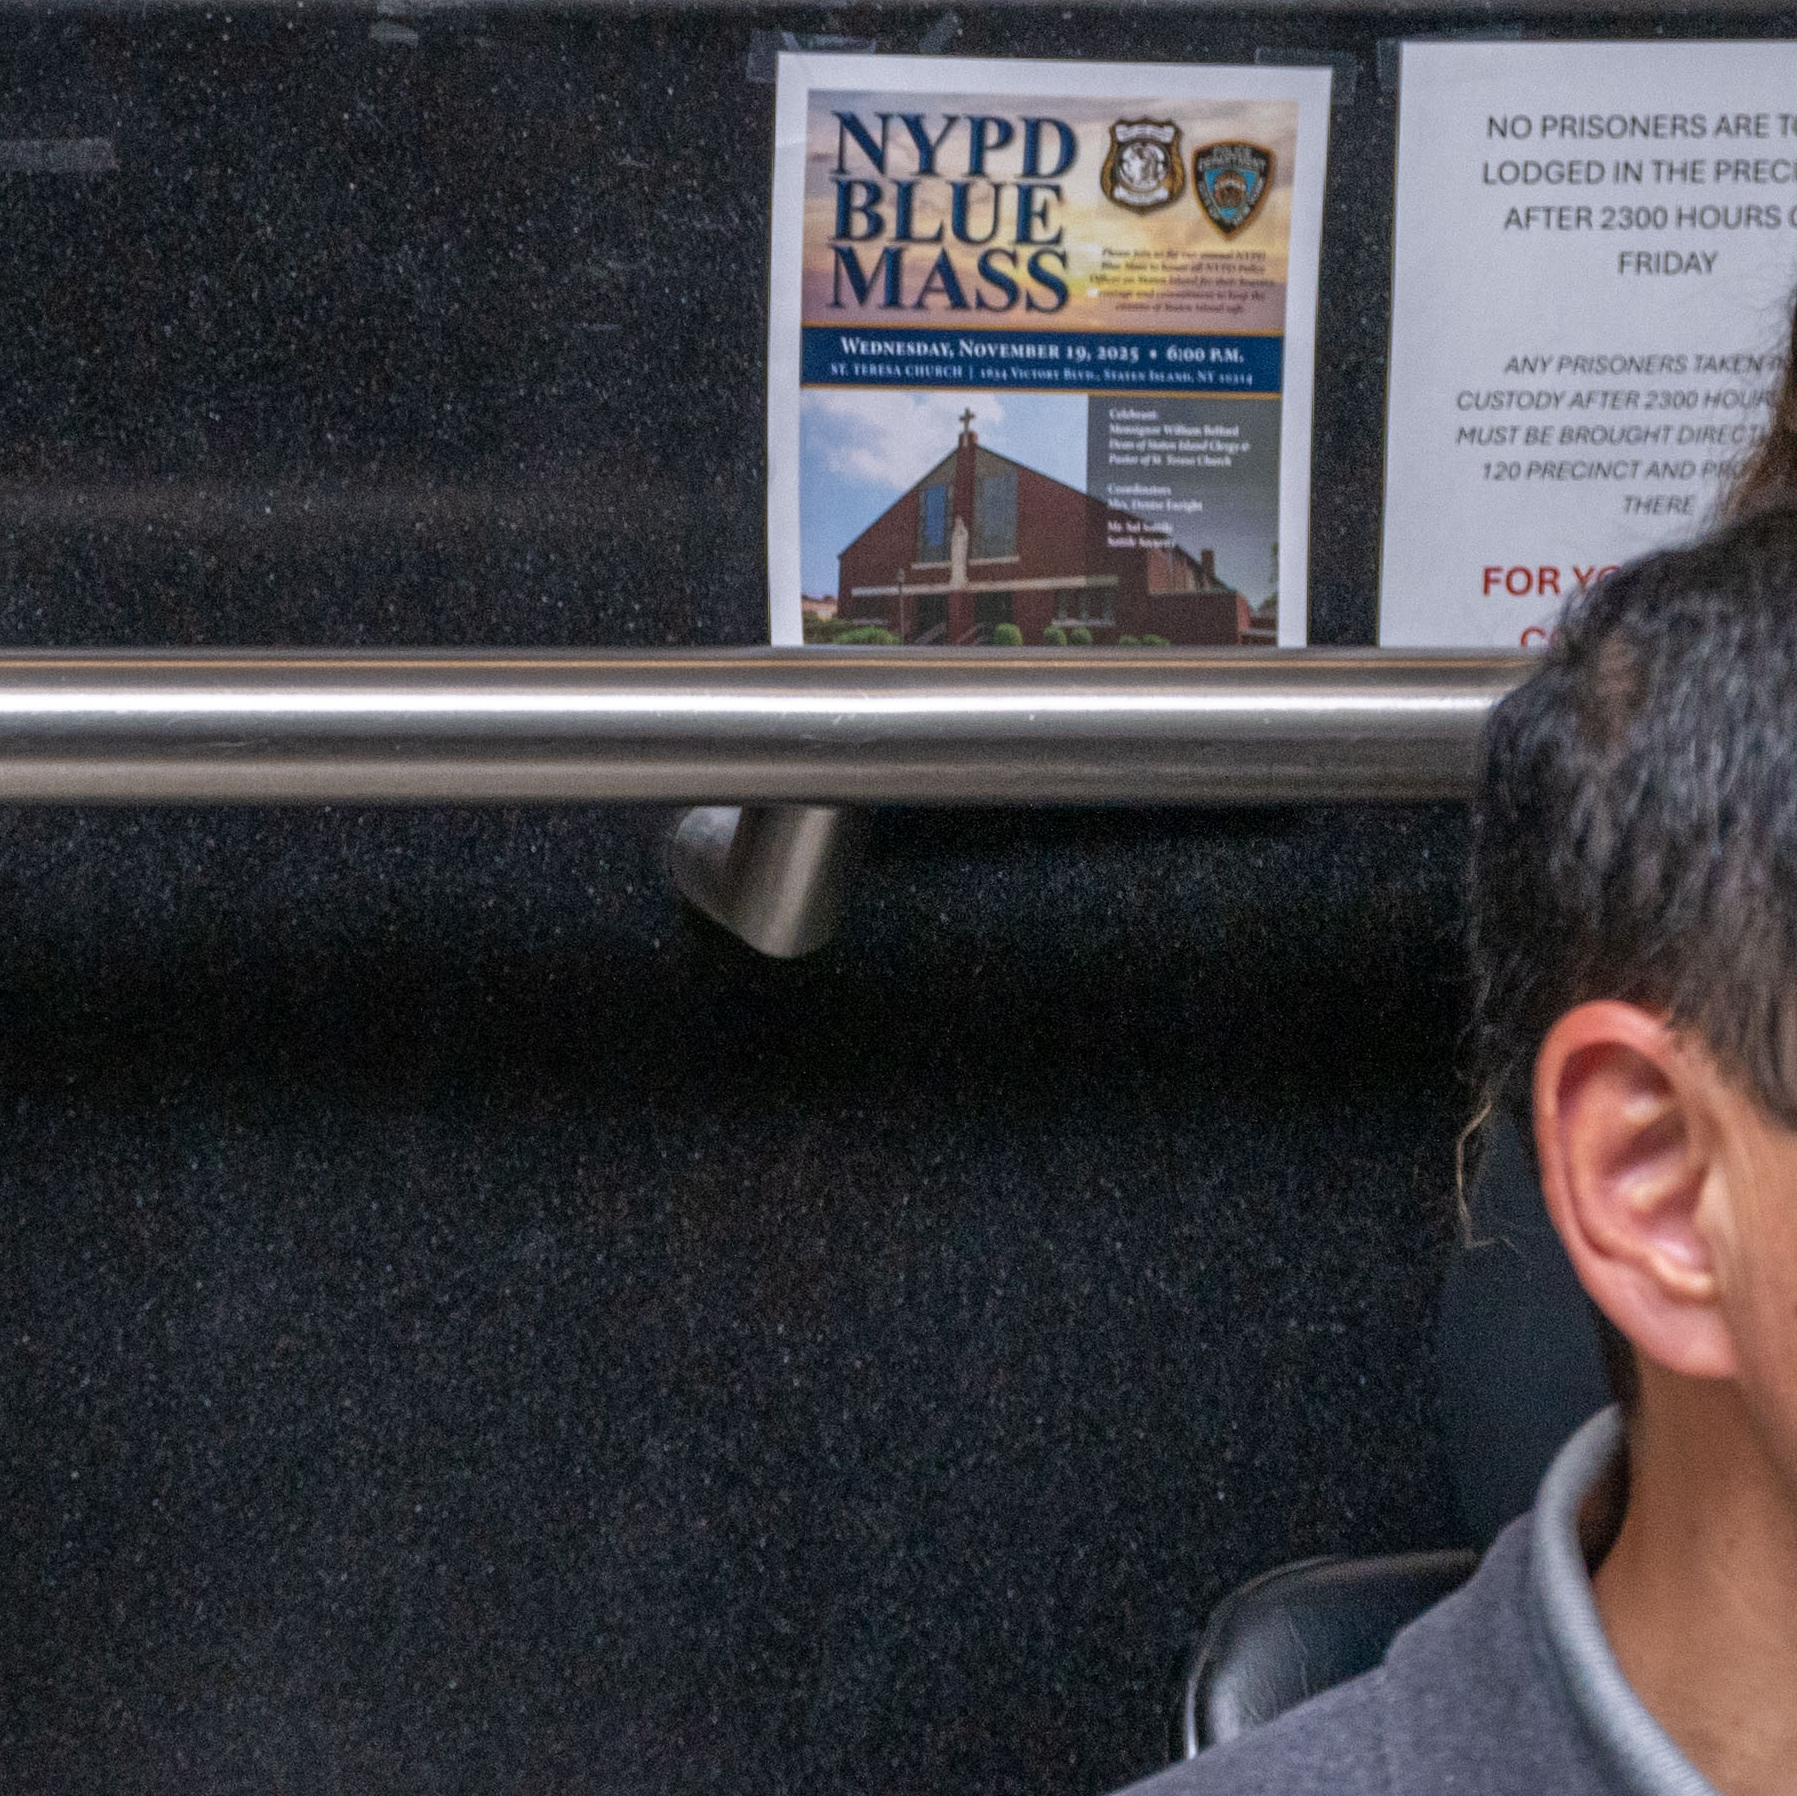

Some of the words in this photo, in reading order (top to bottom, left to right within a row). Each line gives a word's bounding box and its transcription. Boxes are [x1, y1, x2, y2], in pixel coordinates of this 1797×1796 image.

[1487, 113, 1533, 140] NO
[1541, 113, 1706, 140] PRISONERS
[1713, 112, 1770, 139] ARE
[831, 110, 1080, 181] NYPD
[1483, 159, 1605, 186] LODGED
[1613, 159, 1642, 184] IN
[1652, 159, 1705, 184] THE
[831, 178, 1065, 246] BLUE
[1504, 206, 1593, 232] AFTER
[1601, 205, 1668, 231] 2300
[1676, 204, 1781, 230] HOURS
[1618, 250, 1718, 276] FRIDAY
[830, 242, 1070, 315] MASS
[840, 335, 955, 359] WEDNESDAY,
[958, 338, 1061, 361] NOVEMBER
[1066, 345, 1092, 362] 19,
[1096, 346, 1140, 364] 2025
[1165, 344, 1206, 363] 6:00
[1210, 347, 1245, 364] P.M.
[854, 363, 902, 377] TERESA
[905, 364, 963, 379] CHURCH
[1504, 354, 1553, 374] ANY
[1556, 354, 1688, 374] PRISONERS
[1693, 353, 1766, 374] TAKEN
[1456, 389, 1565, 411] CUSTODY
[1570, 389, 1641, 411] AFTER
[1644, 389, 1700, 411] 2300
[1455, 425, 1518, 446] MUST
[1524, 425, 1555, 446] BE
[1559, 425, 1673, 447] BROUGHT
[1483, 461, 1522, 481] 120
[1527, 460, 1641, 481] PRECINCT
[1645, 460, 1697, 480] AND
[1623, 495, 1696, 516] THERE
[1482, 565, 1562, 597] FOR
